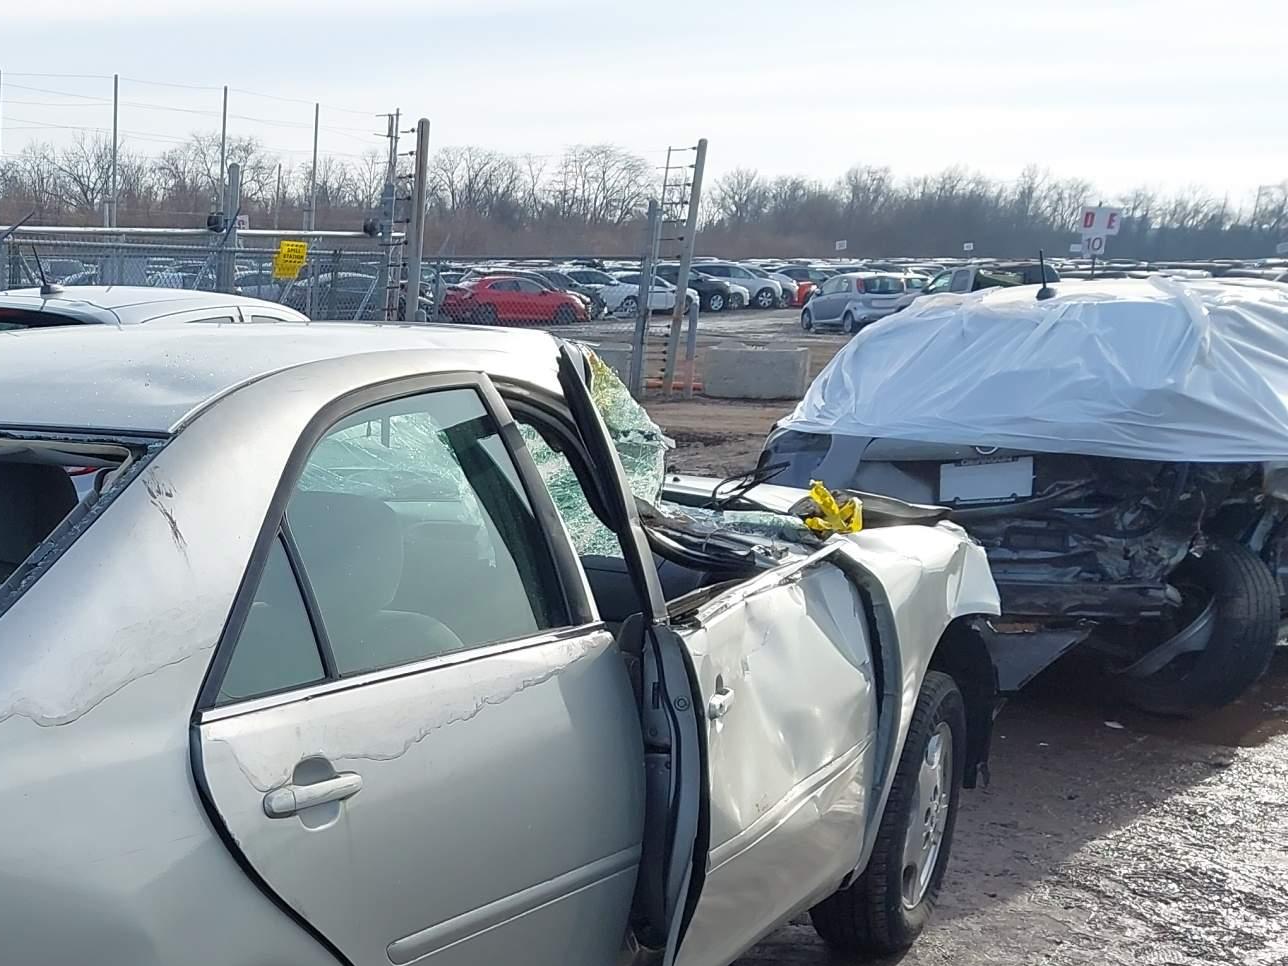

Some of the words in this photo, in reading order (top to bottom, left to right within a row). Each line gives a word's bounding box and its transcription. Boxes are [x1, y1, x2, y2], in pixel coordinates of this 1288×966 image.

[1083, 211, 1095, 228] D
[1106, 212, 1118, 229] E
[1086, 237, 1103, 251] 10
